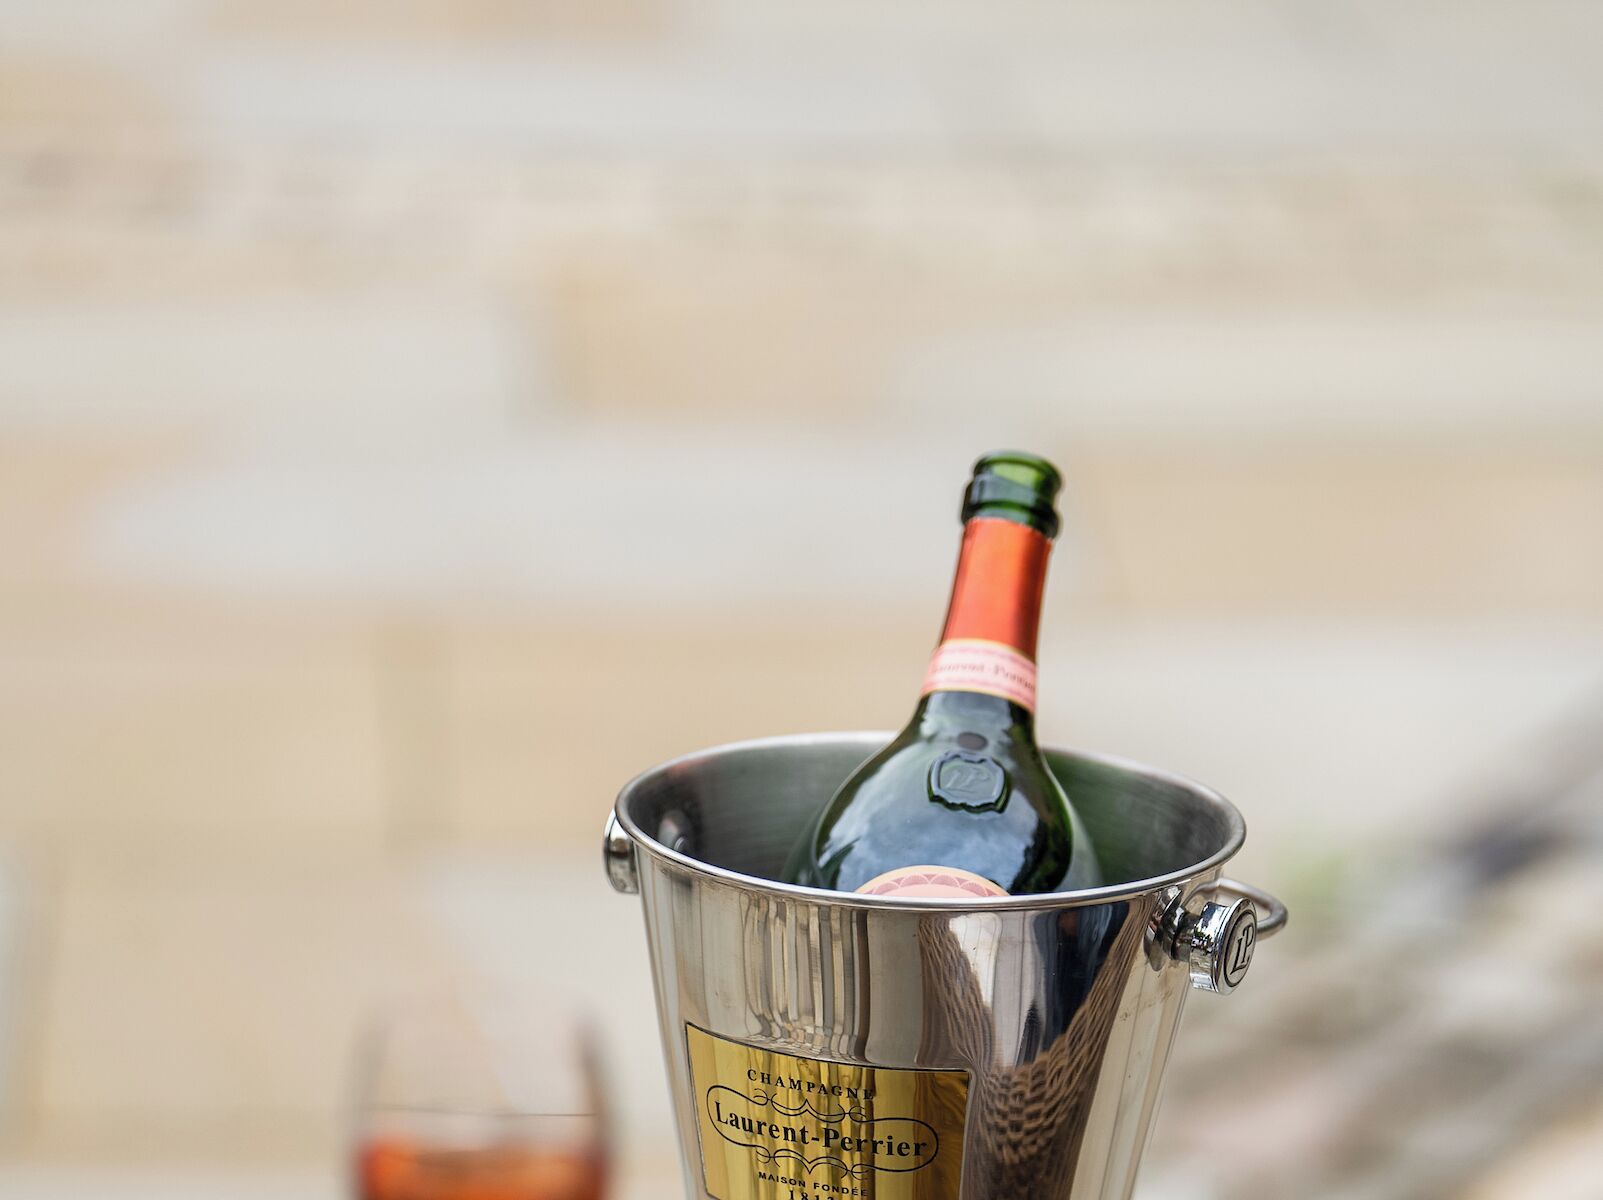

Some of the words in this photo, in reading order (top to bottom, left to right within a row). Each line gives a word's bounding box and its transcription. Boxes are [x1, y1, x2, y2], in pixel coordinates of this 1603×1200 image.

[747, 1069, 875, 1100] CHAMPAGNE
[714, 1101, 928, 1157] Laurent-Perrier
[758, 1171, 806, 1188] MAISON
[813, 1182, 868, 1197] FONDÉE
